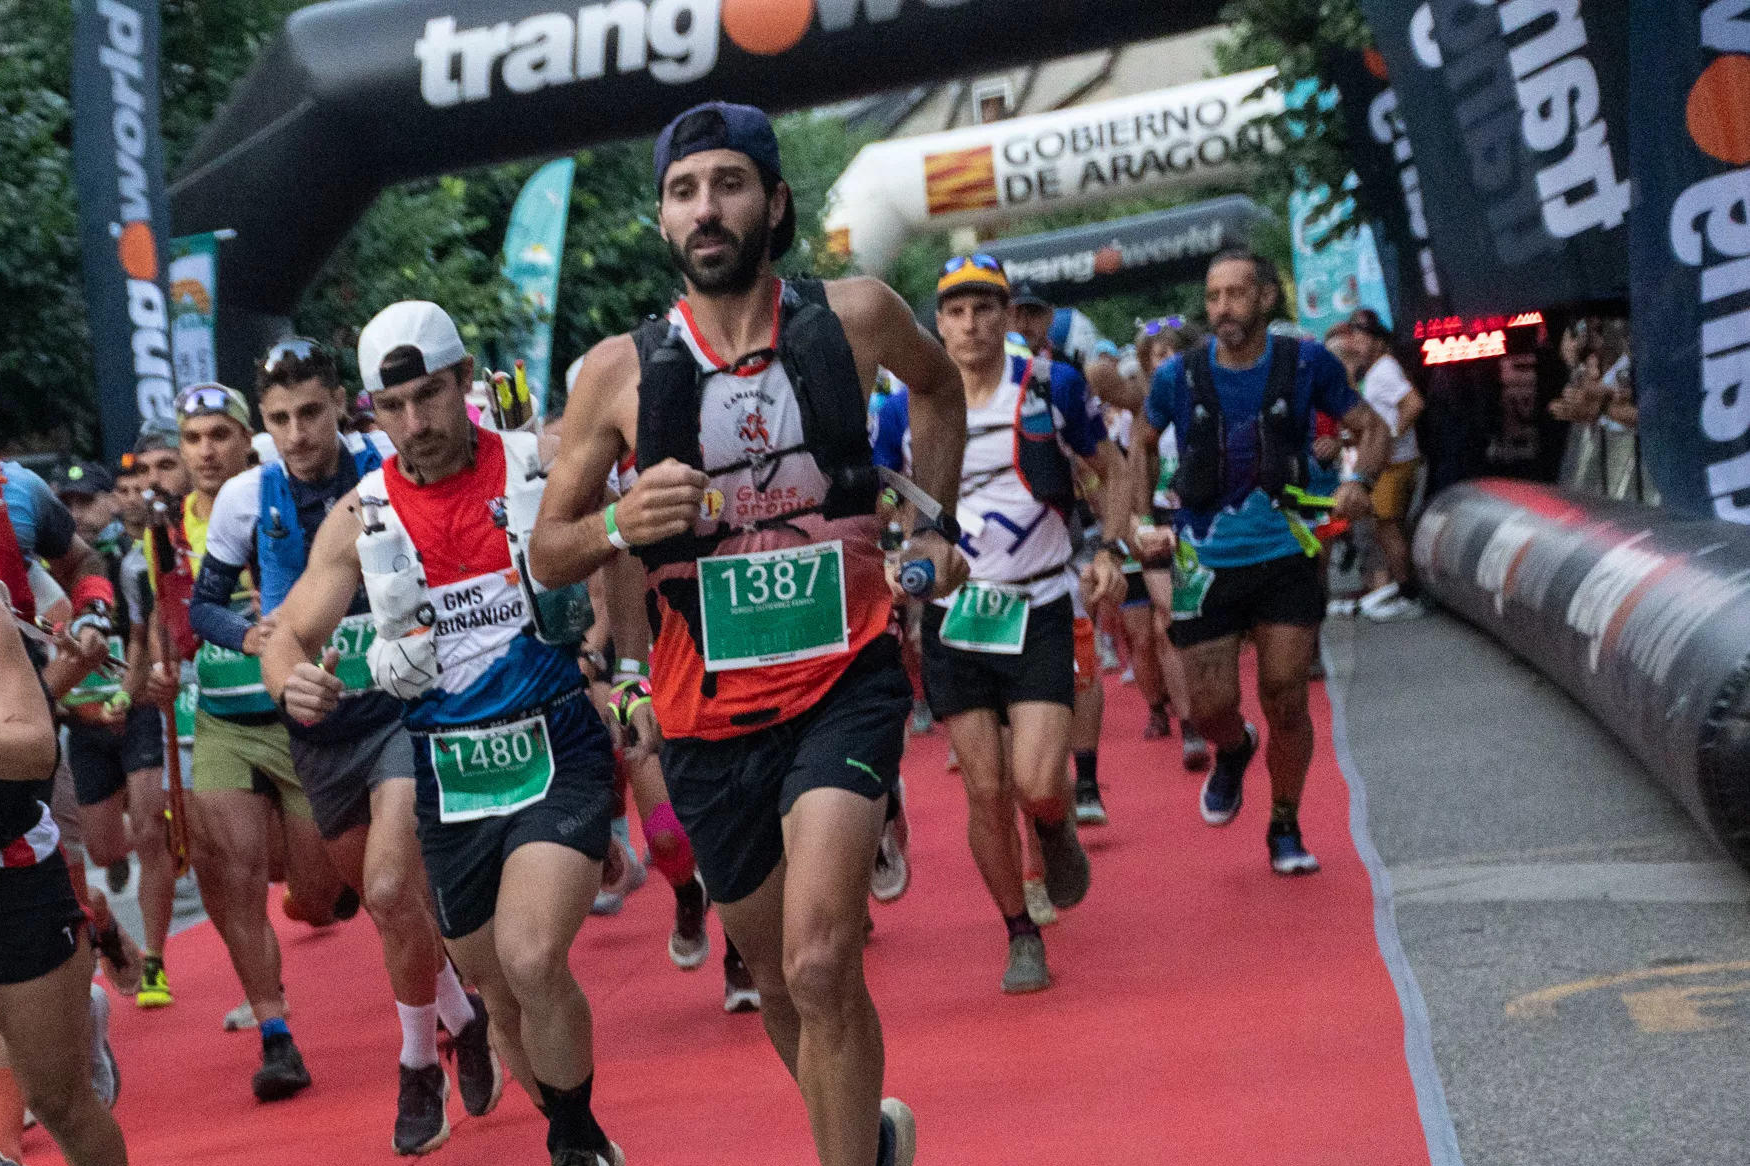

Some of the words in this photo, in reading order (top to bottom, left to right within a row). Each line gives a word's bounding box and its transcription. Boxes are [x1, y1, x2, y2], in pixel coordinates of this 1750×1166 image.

[1002, 97, 1228, 167] GOBIERNO
[1005, 168, 1062, 204] DE
[442, 585, 485, 612] GMS
[720, 556, 822, 607] 1387
[434, 600, 524, 637] BIÑANIGO
[448, 730, 534, 774] 1480
